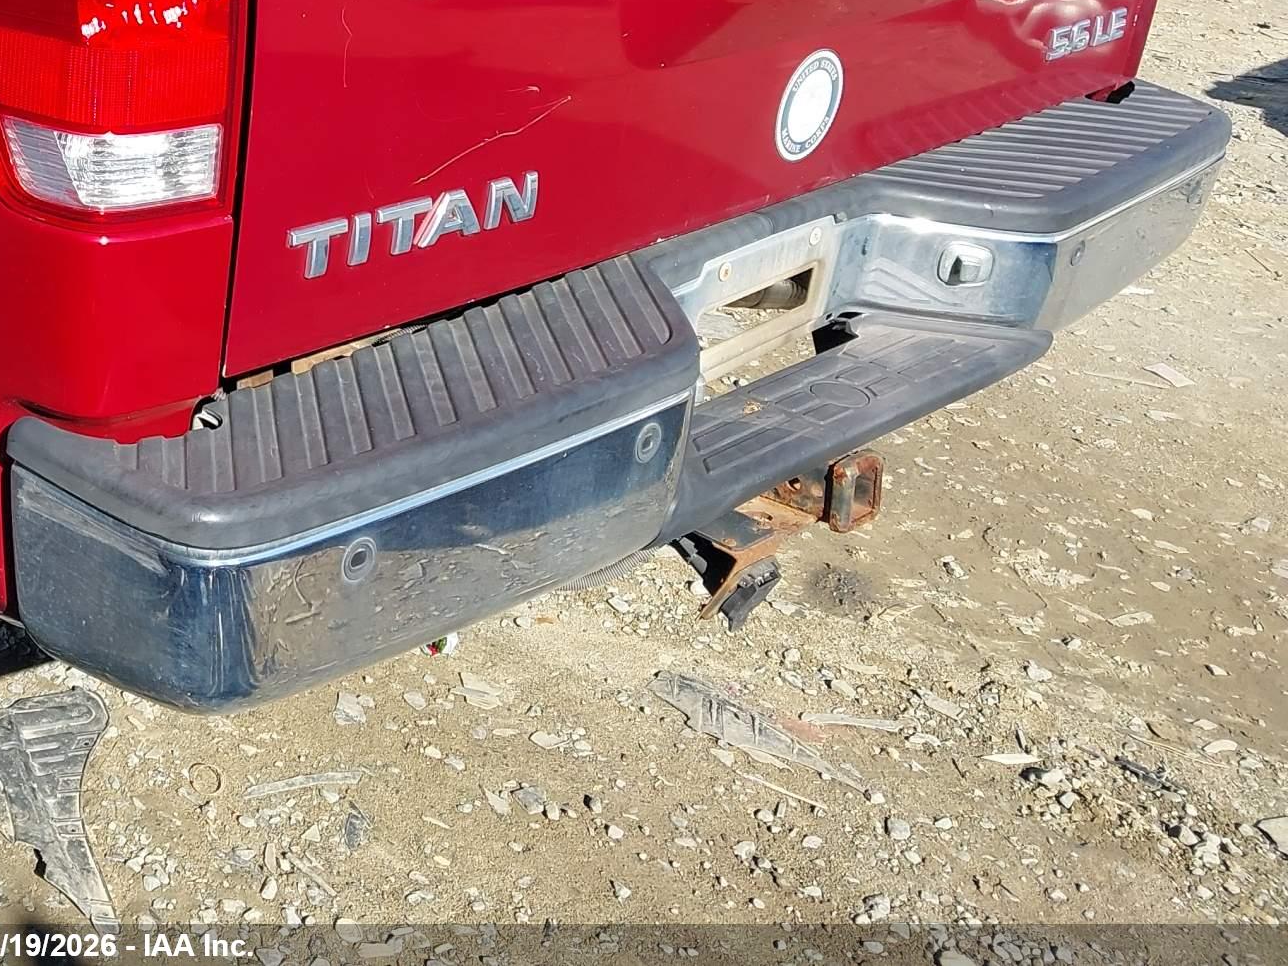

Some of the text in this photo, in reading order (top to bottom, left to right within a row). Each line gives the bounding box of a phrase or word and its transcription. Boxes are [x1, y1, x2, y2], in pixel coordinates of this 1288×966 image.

[1088, 6, 1128, 48] LE
[792, 60, 820, 92] UNITED
[286, 170, 539, 279] TITAN
